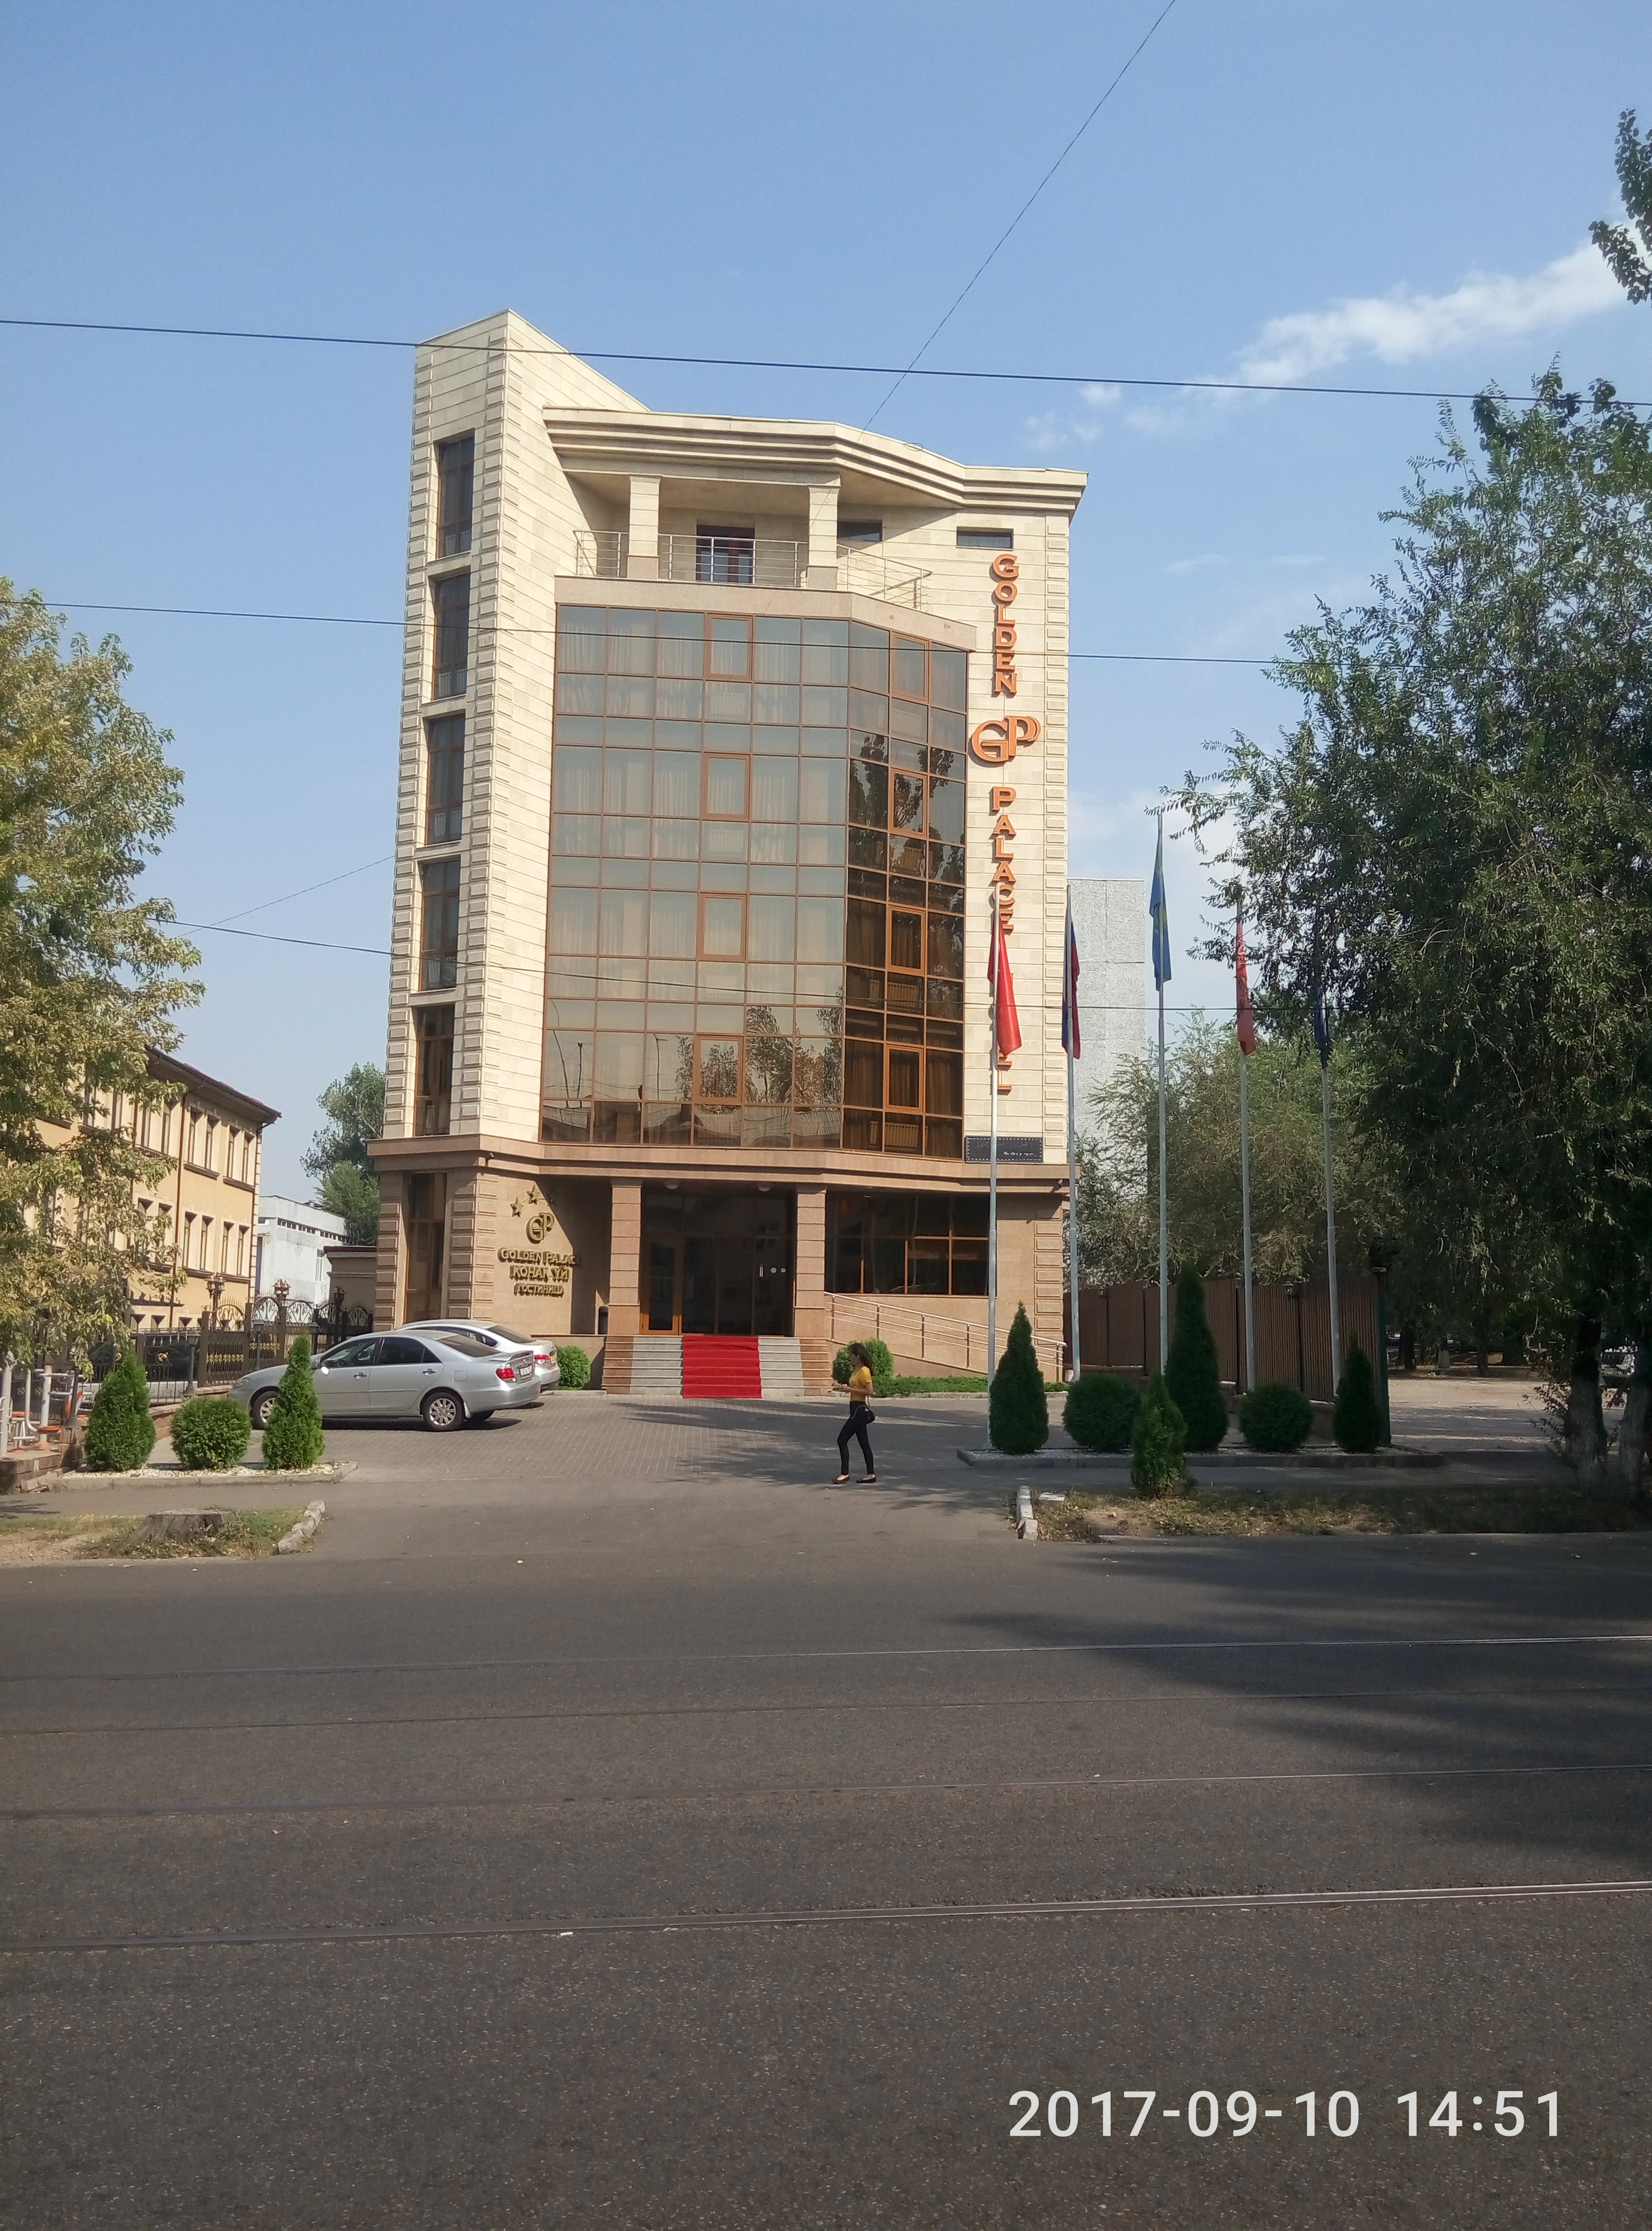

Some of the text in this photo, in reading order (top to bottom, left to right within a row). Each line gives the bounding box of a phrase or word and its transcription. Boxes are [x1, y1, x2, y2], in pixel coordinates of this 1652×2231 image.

[993, 554, 1019, 693] GOLDEN
[498, 1248, 543, 1263] GOLDEN
[514, 1283, 564, 1296] ГОСТИНИЦА
